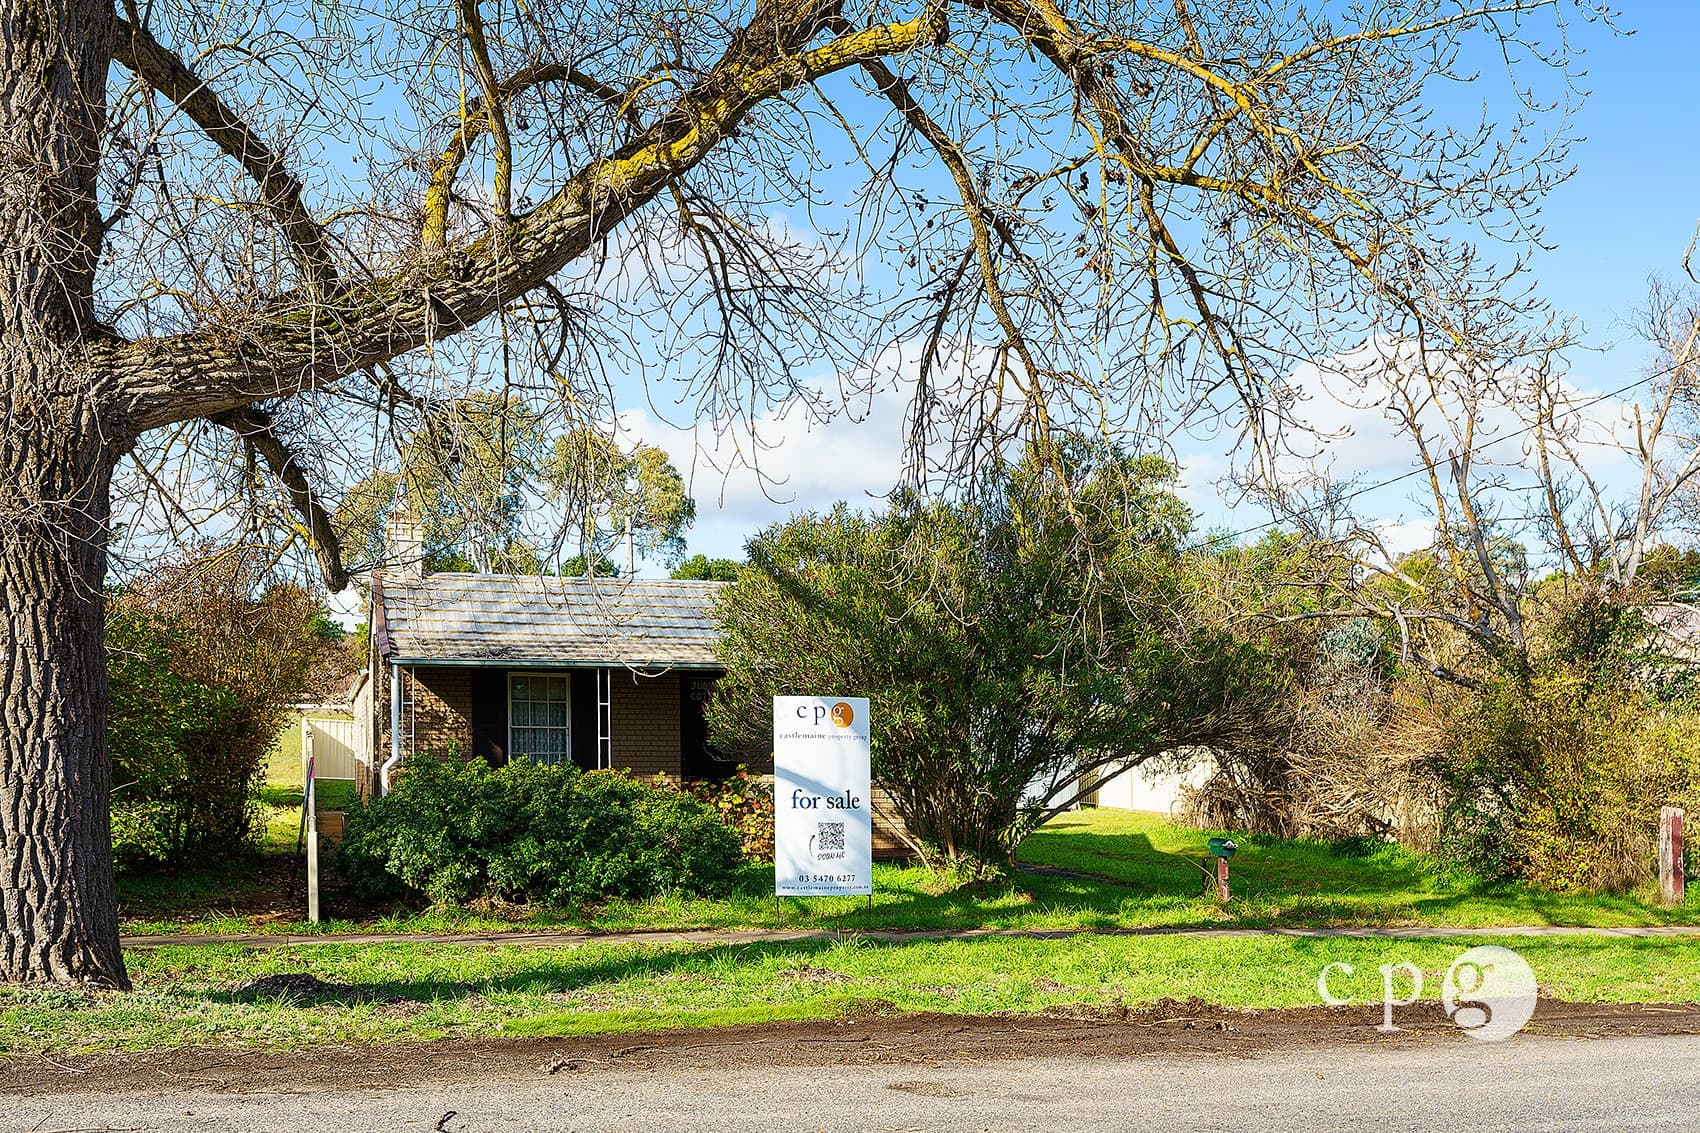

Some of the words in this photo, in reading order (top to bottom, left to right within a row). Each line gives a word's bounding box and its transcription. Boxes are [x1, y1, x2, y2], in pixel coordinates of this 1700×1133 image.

[796, 702, 854, 728] cpg
[779, 731, 827, 740] castlemaine
[791, 789, 821, 809] for
[826, 789, 860, 810] sale
[798, 874, 810, 883] 03
[812, 874, 834, 883] 5470
[836, 874, 856, 883] 6277
